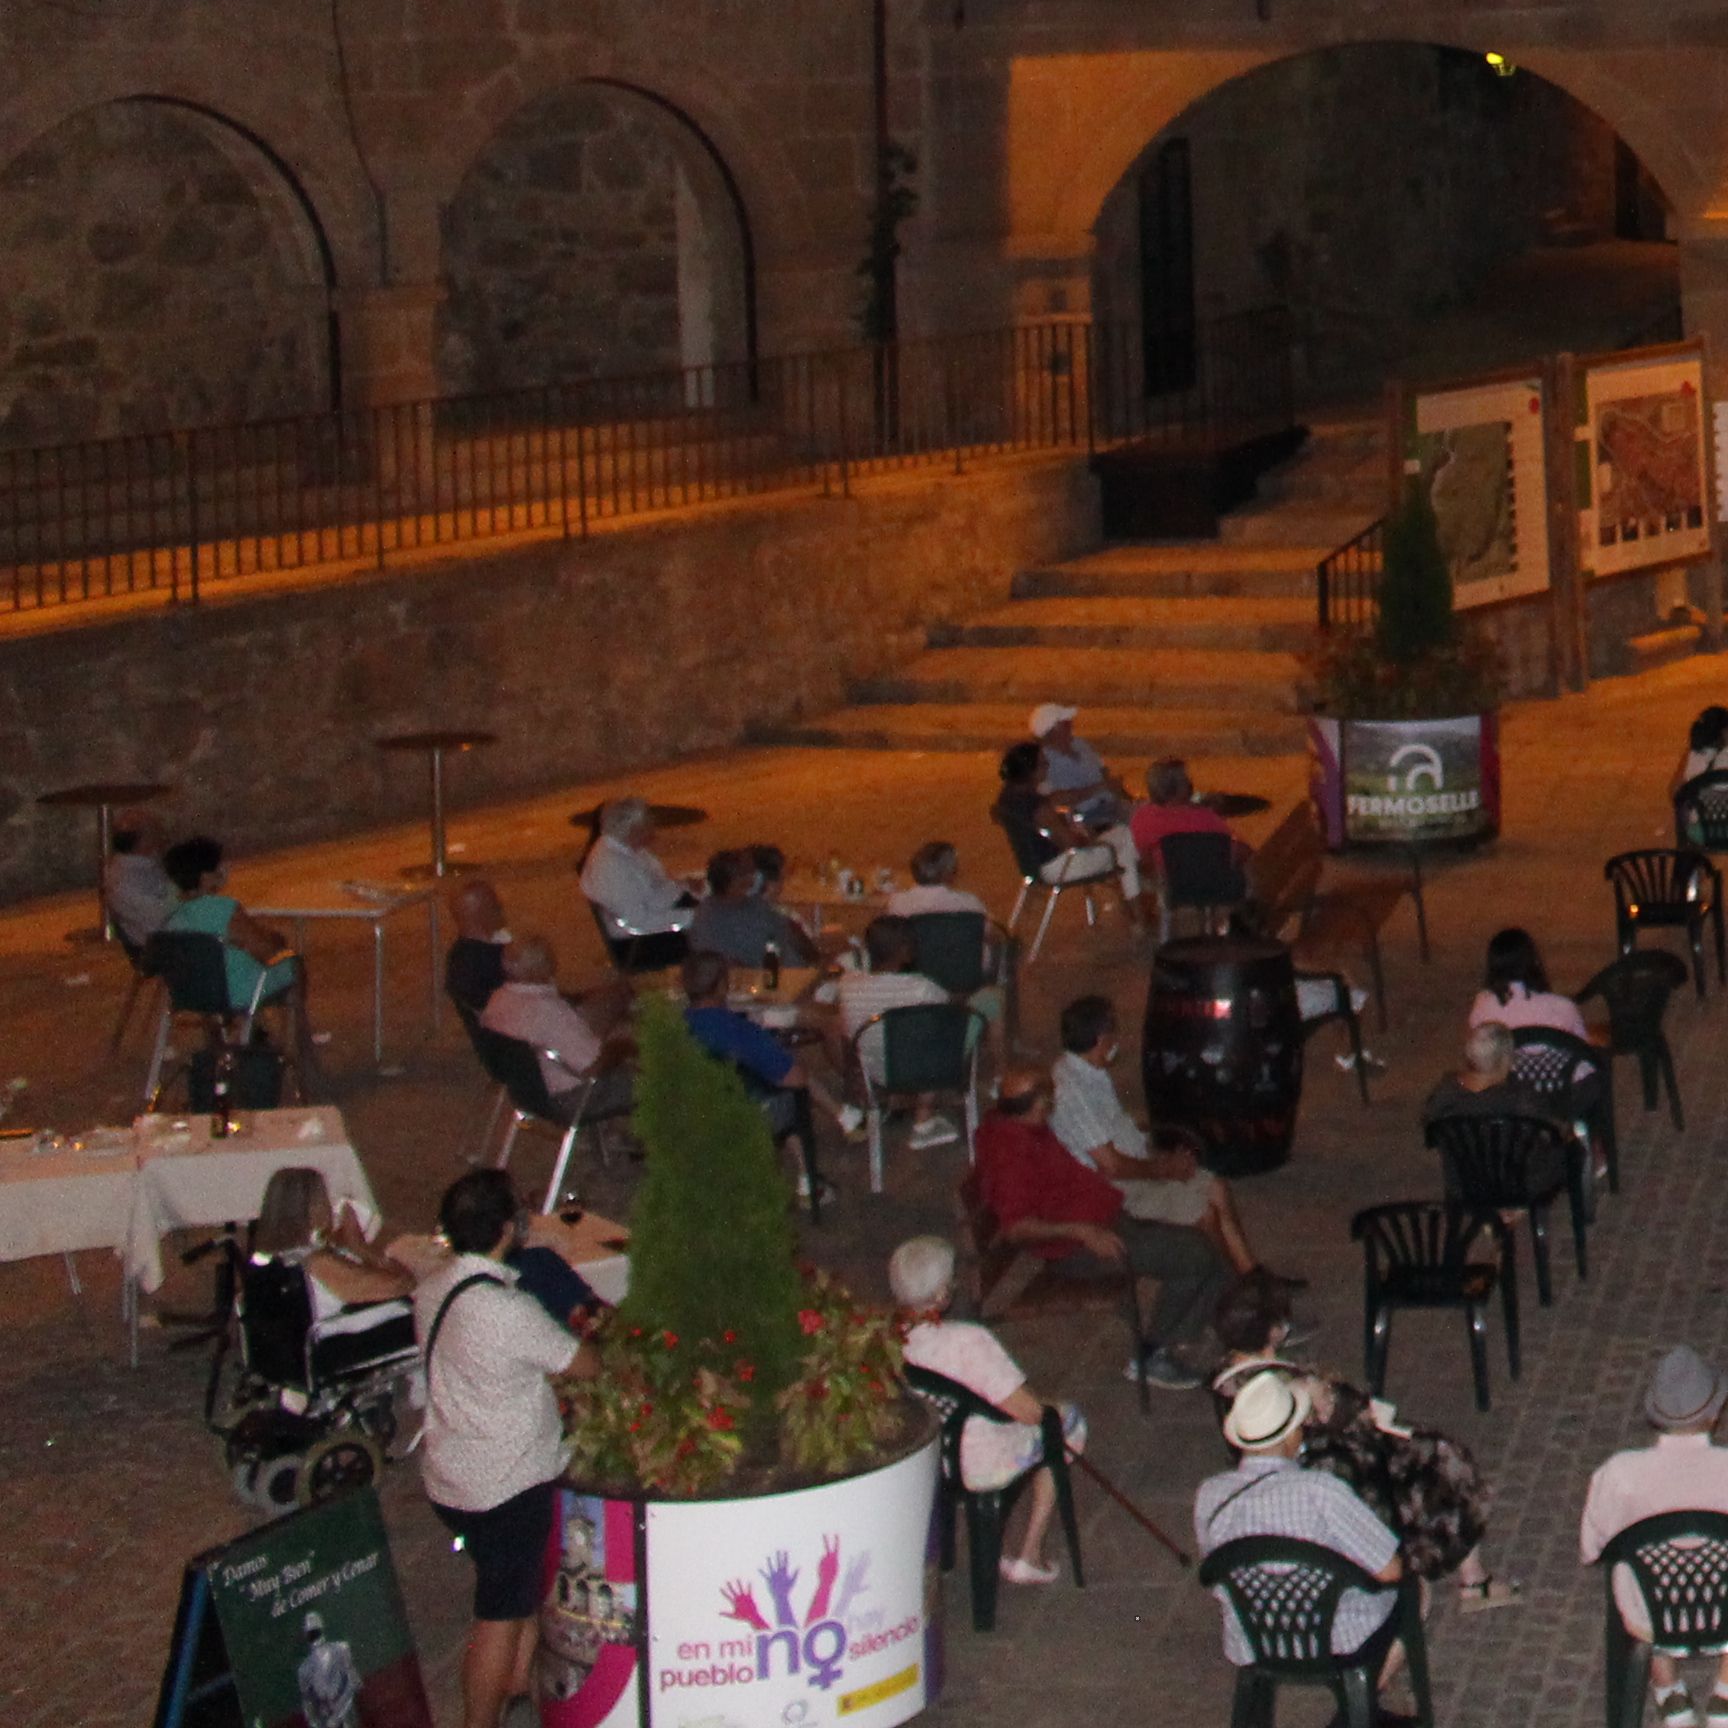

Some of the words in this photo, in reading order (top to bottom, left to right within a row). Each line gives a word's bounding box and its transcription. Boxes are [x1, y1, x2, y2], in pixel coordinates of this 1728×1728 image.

[1347, 788, 1480, 817] FERMOSELLE
[221, 1551, 270, 1588] Damos
[271, 1597, 288, 1619] de
[289, 1575, 330, 1610] Comer
[340, 1551, 380, 1583] Cenar
[676, 1640, 711, 1661] en
[719, 1633, 753, 1657] mi
[660, 1663, 754, 1693] pueblo
